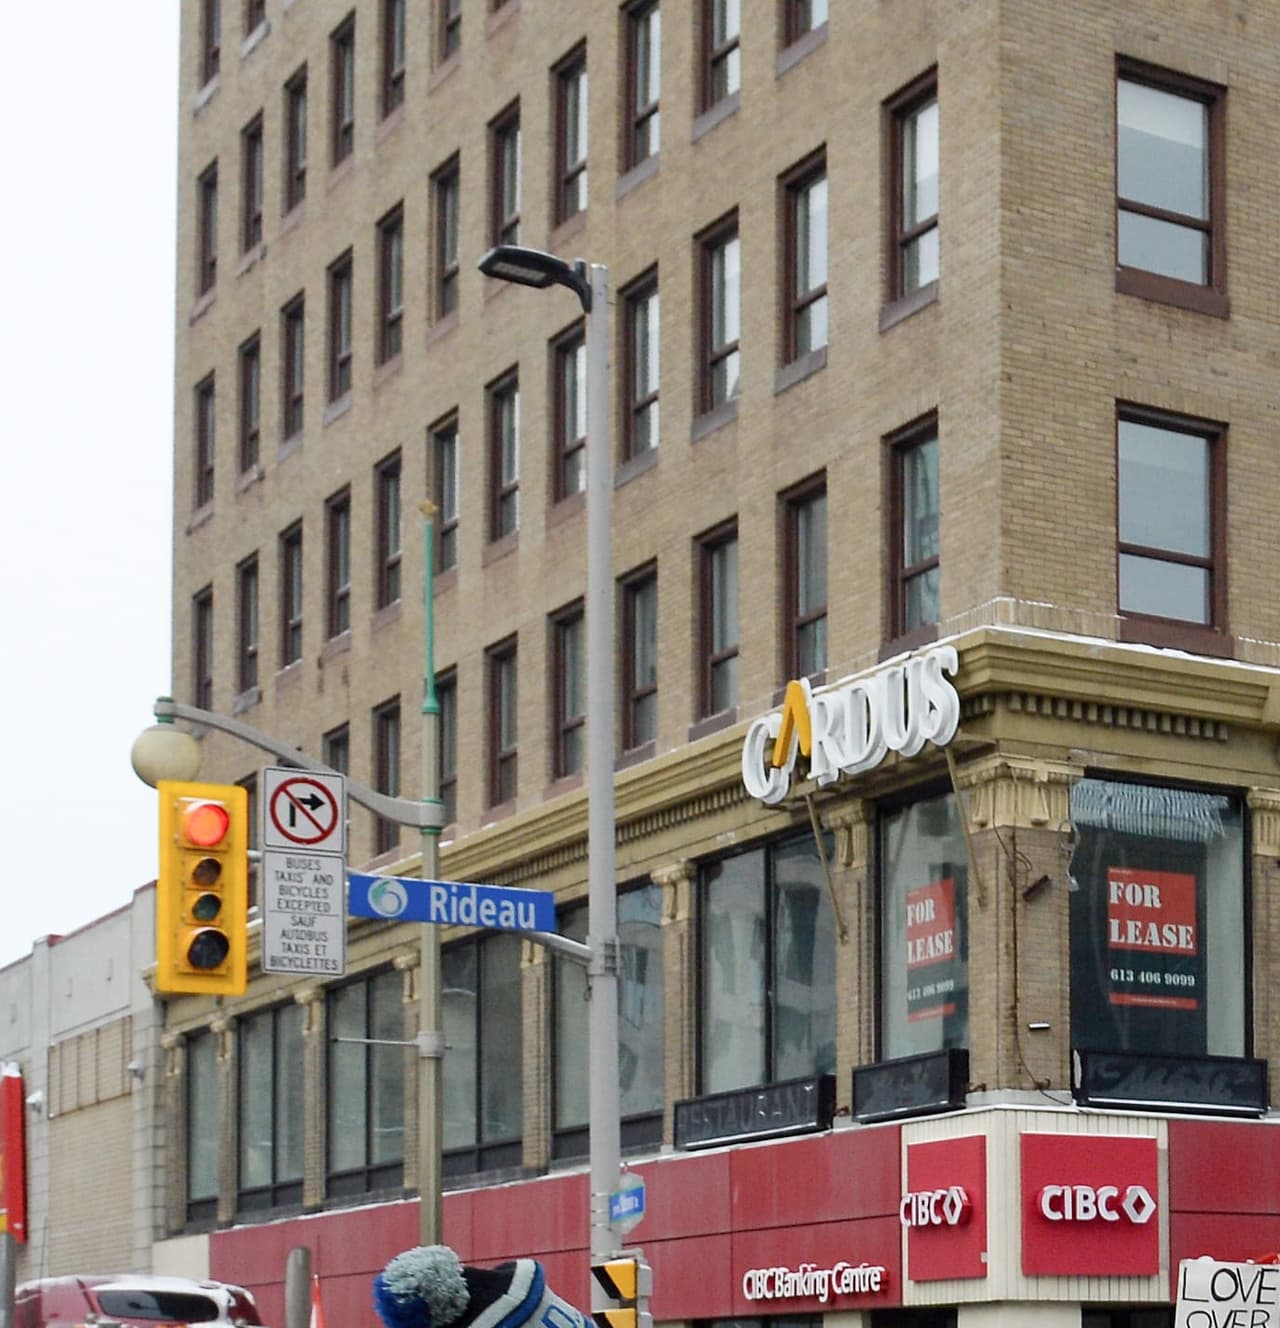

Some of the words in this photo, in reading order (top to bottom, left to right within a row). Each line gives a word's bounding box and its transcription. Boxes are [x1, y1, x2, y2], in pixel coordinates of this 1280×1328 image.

[742, 645, 960, 804] CARDUS
[286, 857, 321, 871] BUSES
[279, 884, 329, 899] BICYCLES
[312, 874, 334, 886] AND
[277, 898, 332, 913] EXCEPTED
[430, 885, 536, 929] Rideau
[1109, 881, 1162, 909] FOR
[291, 915, 317, 927] SAUF
[907, 898, 936, 928] FOR
[281, 929, 328, 942] AUTOBUS
[907, 929, 954, 964] LEASE
[1109, 918, 1194, 949] LEASE
[270, 955, 338, 971] BICYCLETTES
[281, 942, 311, 954] TAXIS
[315, 944, 327, 956] ET
[1110, 968, 1134, 982] 613
[1139, 971, 1161, 984] 406
[1164, 973, 1195, 987] 9099
[900, 1190, 943, 1227] CIBC
[1041, 1185, 1121, 1221] CIBC
[743, 1269, 775, 1300] CIBC
[775, 1264, 830, 1303] Banking
[832, 1262, 885, 1294] Centre
[1182, 1266, 1280, 1305] LOVE
